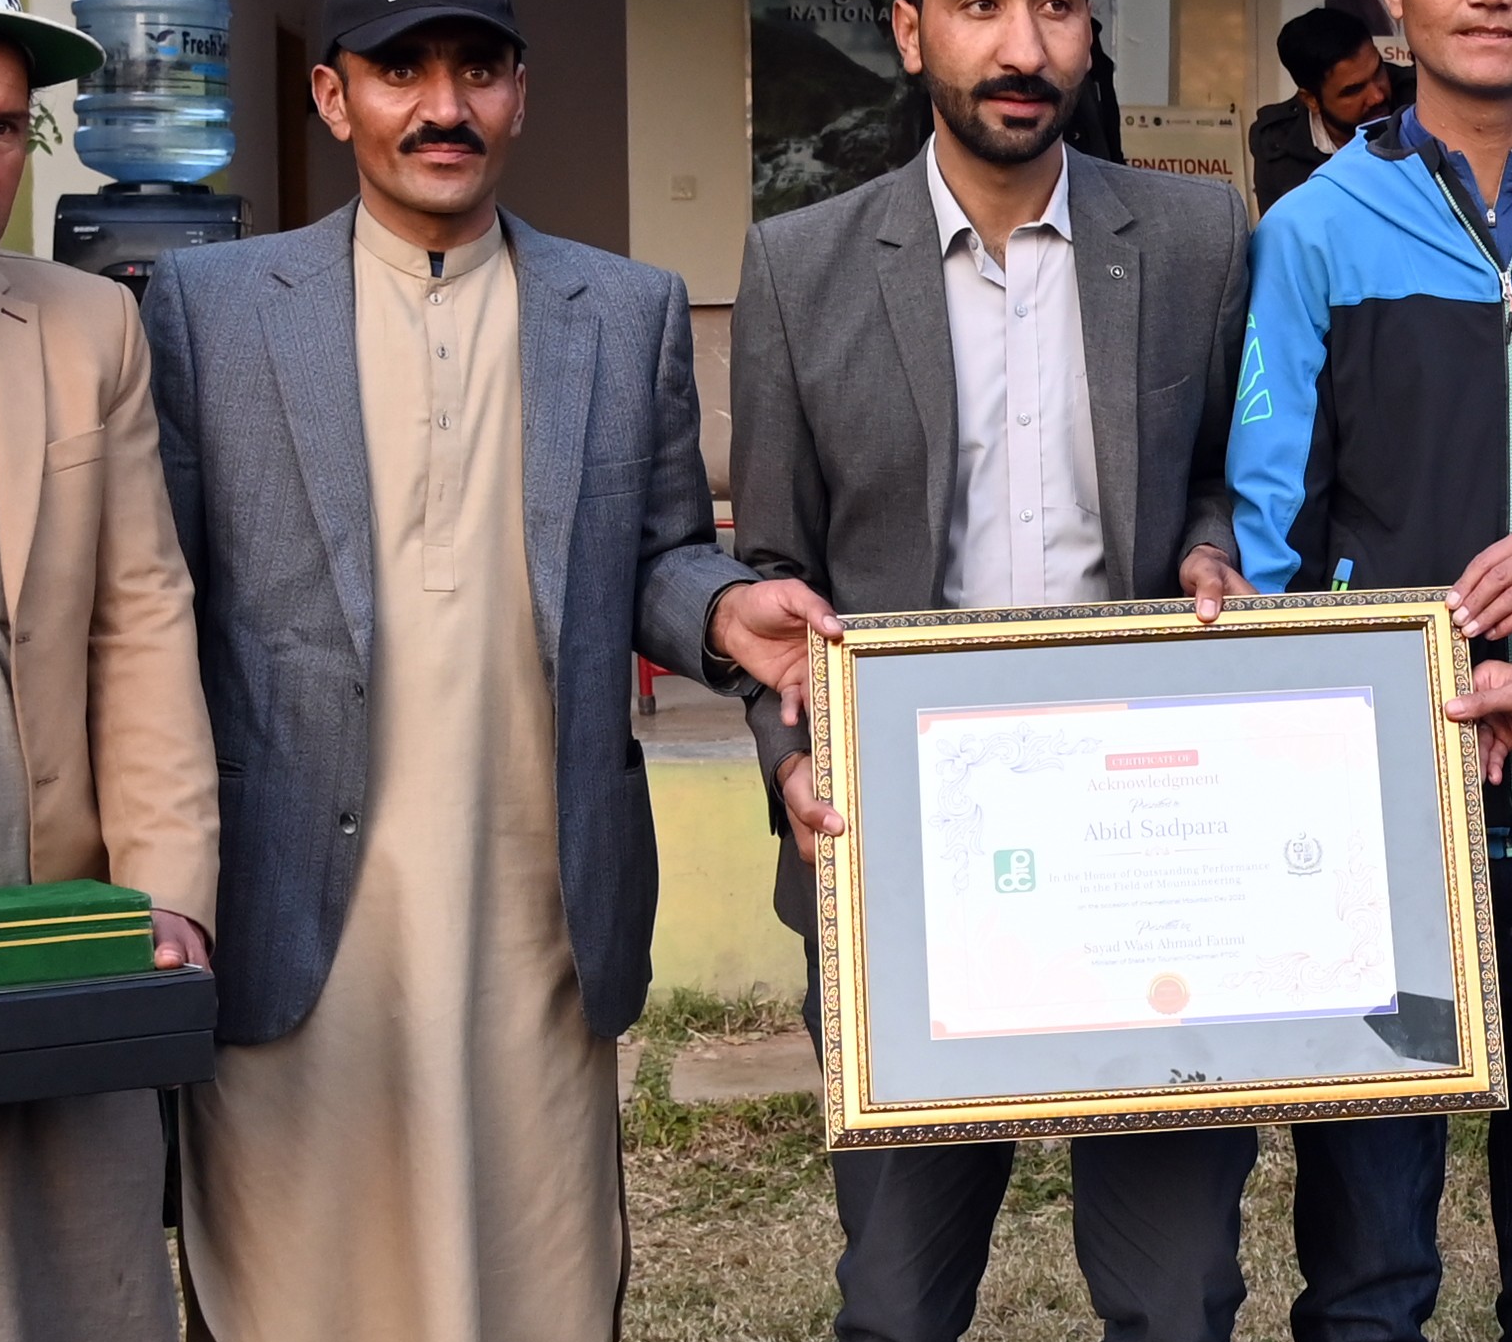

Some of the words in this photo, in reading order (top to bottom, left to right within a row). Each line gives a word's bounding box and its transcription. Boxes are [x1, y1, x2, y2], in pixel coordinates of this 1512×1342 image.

[790, 4, 892, 22] NATIONA
[1125, 158, 1233, 175] RNATIONAL
[1111, 754, 1174, 767] CERTIFICATE
[1176, 753, 1192, 763] OF
[1086, 772, 1221, 792] Acknowledgment
[1083, 819, 1133, 842] Abid
[1139, 816, 1230, 841] Sadpara
[1048, 872, 1061, 884] In
[1063, 871, 1081, 883] the
[1084, 869, 1118, 882] Honor
[1120, 868, 1132, 880] of
[1133, 864, 1200, 879] Outstanding
[1202, 861, 1271, 875] Performance
[1093, 881, 1111, 893] the
[1114, 879, 1141, 892] Field
[1143, 879, 1155, 890] of
[1156, 876, 1242, 891] Mountaineering
[1083, 942, 1121, 956] Sayad
[1124, 939, 1154, 952] Wasi
[1157, 936, 1202, 950] Ahmad
